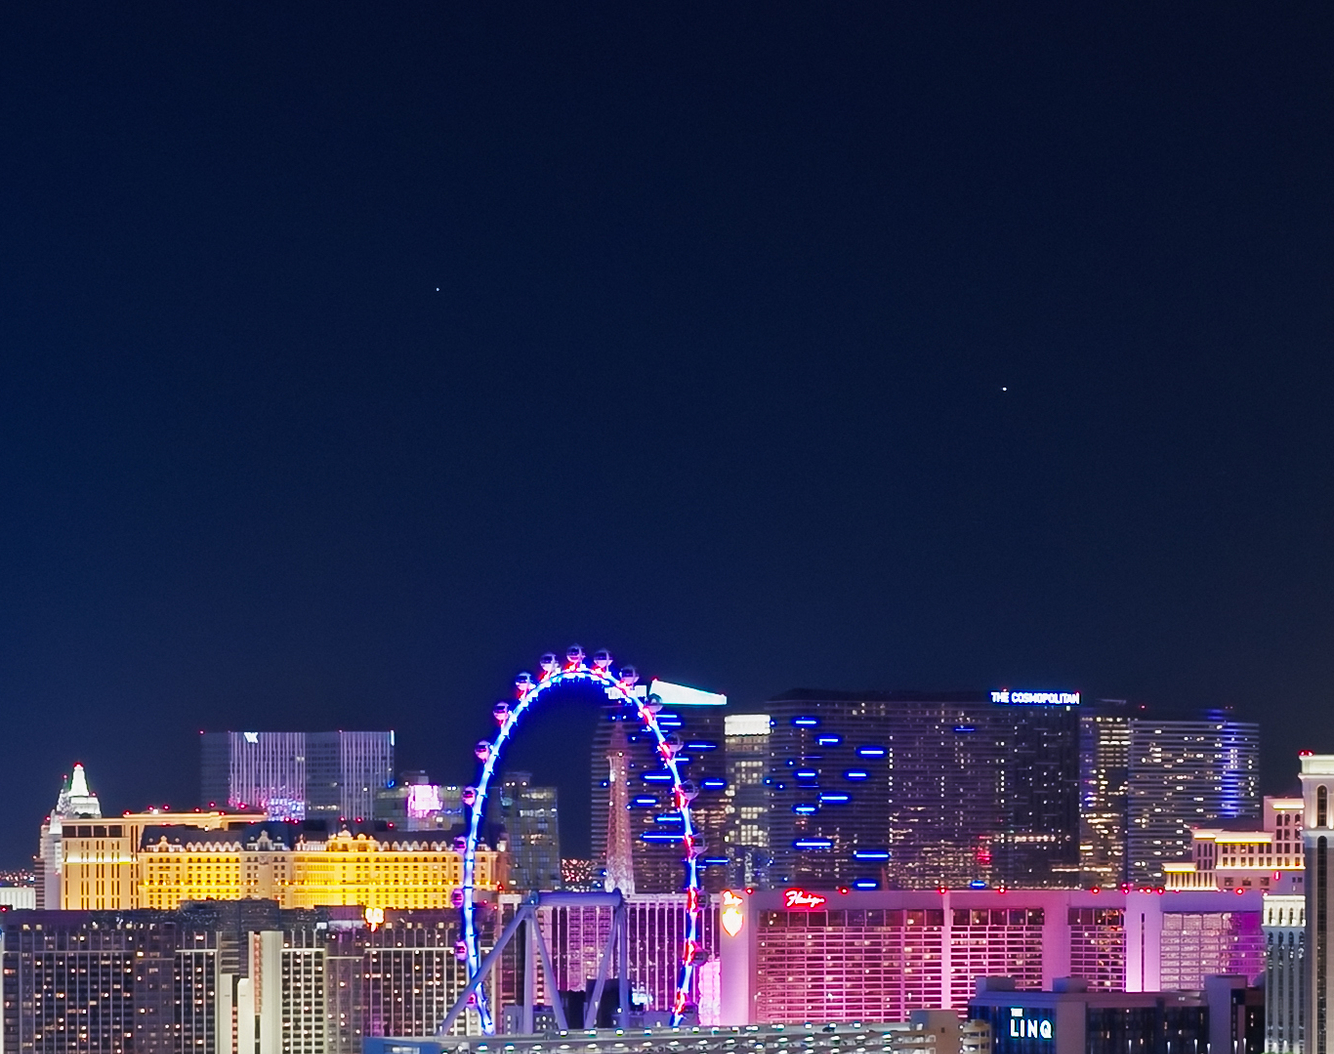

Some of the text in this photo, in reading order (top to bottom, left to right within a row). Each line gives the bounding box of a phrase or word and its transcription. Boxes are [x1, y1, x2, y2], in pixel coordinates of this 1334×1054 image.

[990, 691, 1080, 704] THE COSMOPOLITAN
[1010, 1019, 1052, 1038] LINQ
